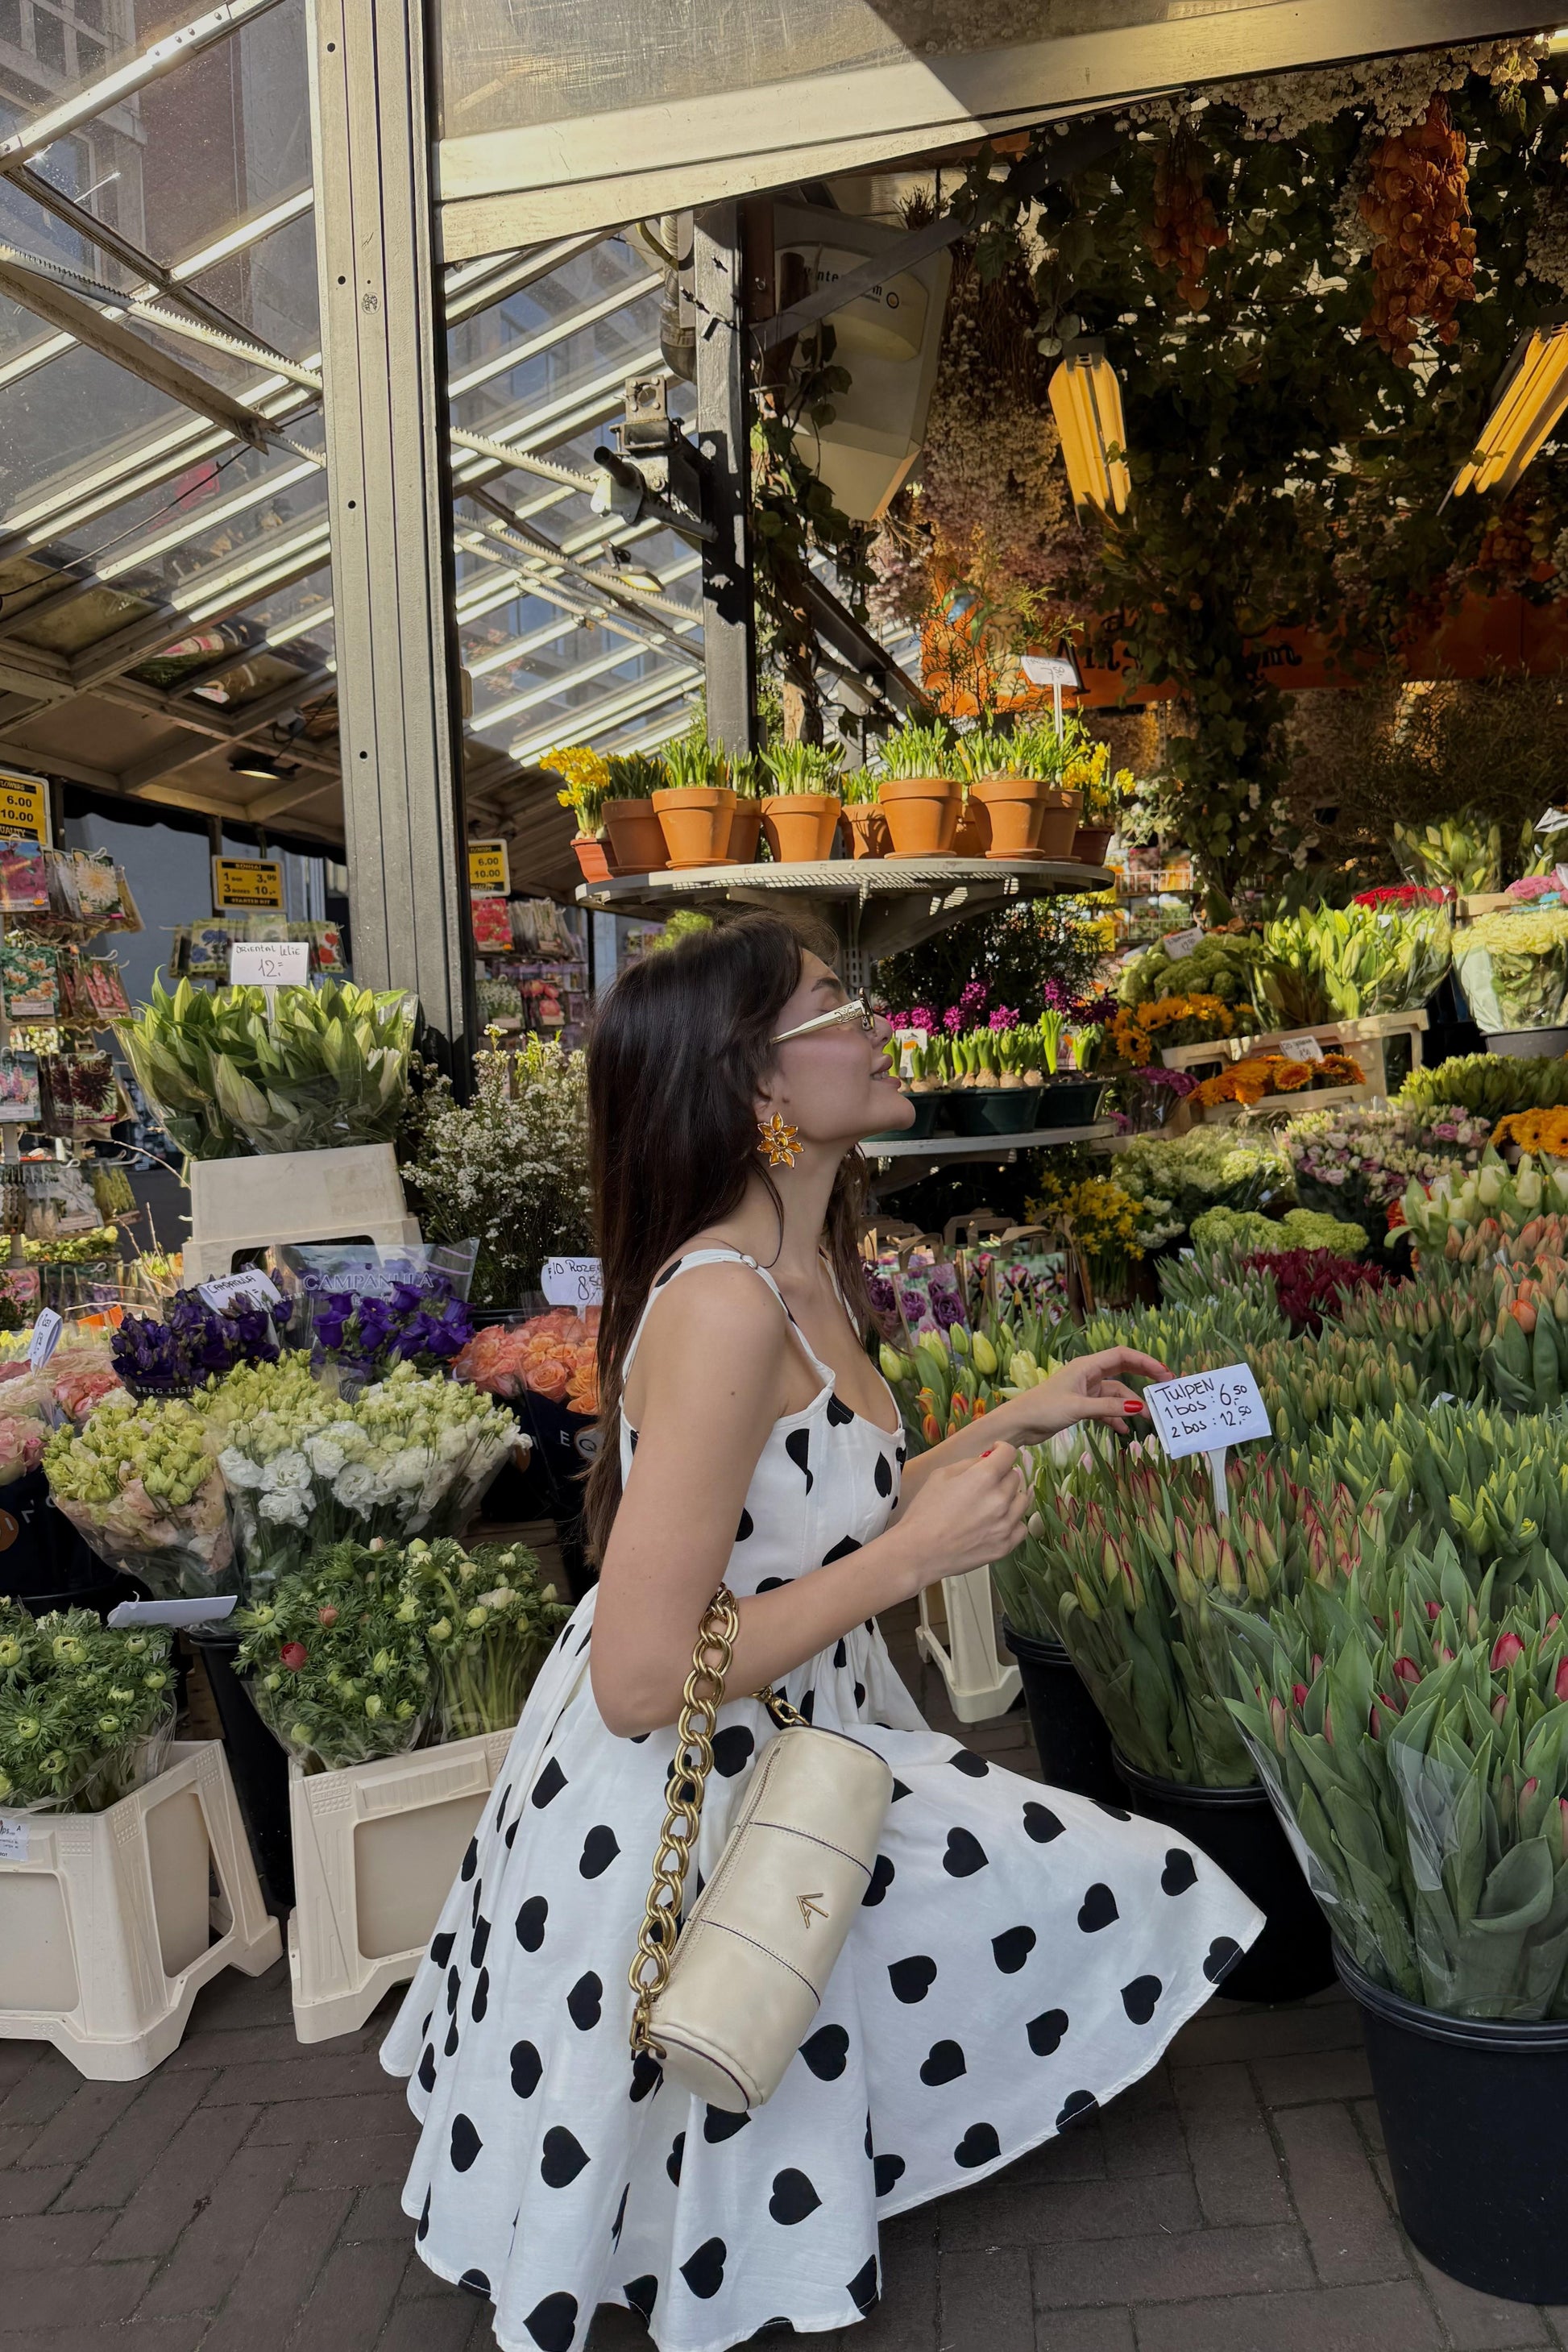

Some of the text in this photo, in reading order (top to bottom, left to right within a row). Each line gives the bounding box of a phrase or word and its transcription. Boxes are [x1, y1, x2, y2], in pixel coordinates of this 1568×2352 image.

[6, 794, 32, 808] 6.00
[0, 808, 34, 823] 10.00
[0, 824, 26, 838] UALITY
[478, 857, 499, 867] 6.00
[224, 872, 230, 881] 1
[475, 869, 500, 878] 10.00
[224, 883, 231, 893] 3
[552, 1262, 564, 1275] 10
[1164, 1406, 1174, 1419] 1
[1174, 1400, 1207, 1416] bos
[1172, 1426, 1180, 1438] 2
[1181, 1420, 1207, 1435] bos
